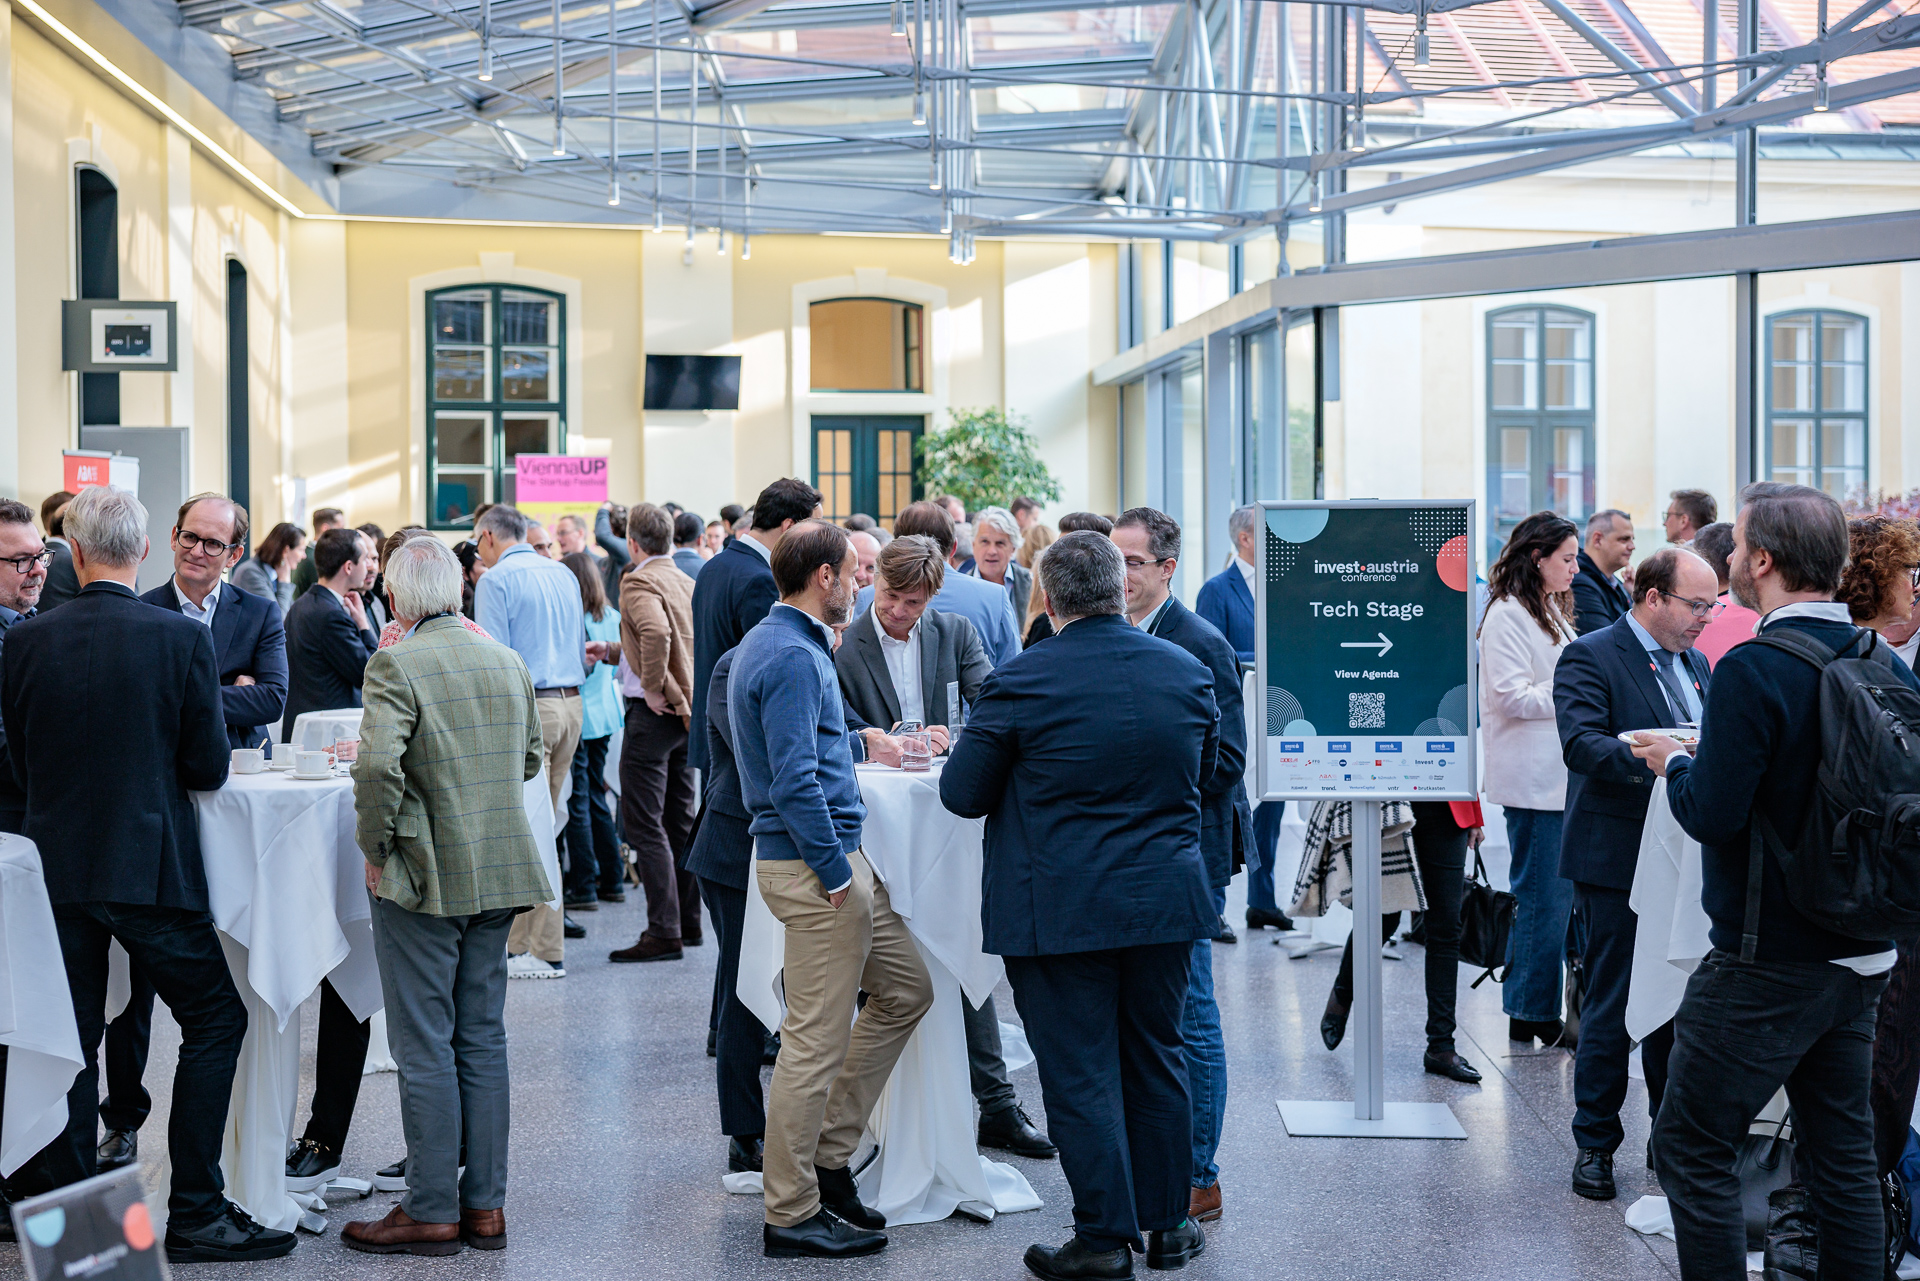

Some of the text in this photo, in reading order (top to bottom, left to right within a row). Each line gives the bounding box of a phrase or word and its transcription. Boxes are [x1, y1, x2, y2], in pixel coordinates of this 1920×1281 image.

[519, 459, 606, 475] ViennaUP
[1341, 573, 1397, 582] conference
[1309, 600, 1424, 621] Tech Stage
[1334, 670, 1400, 681] View Agenda
